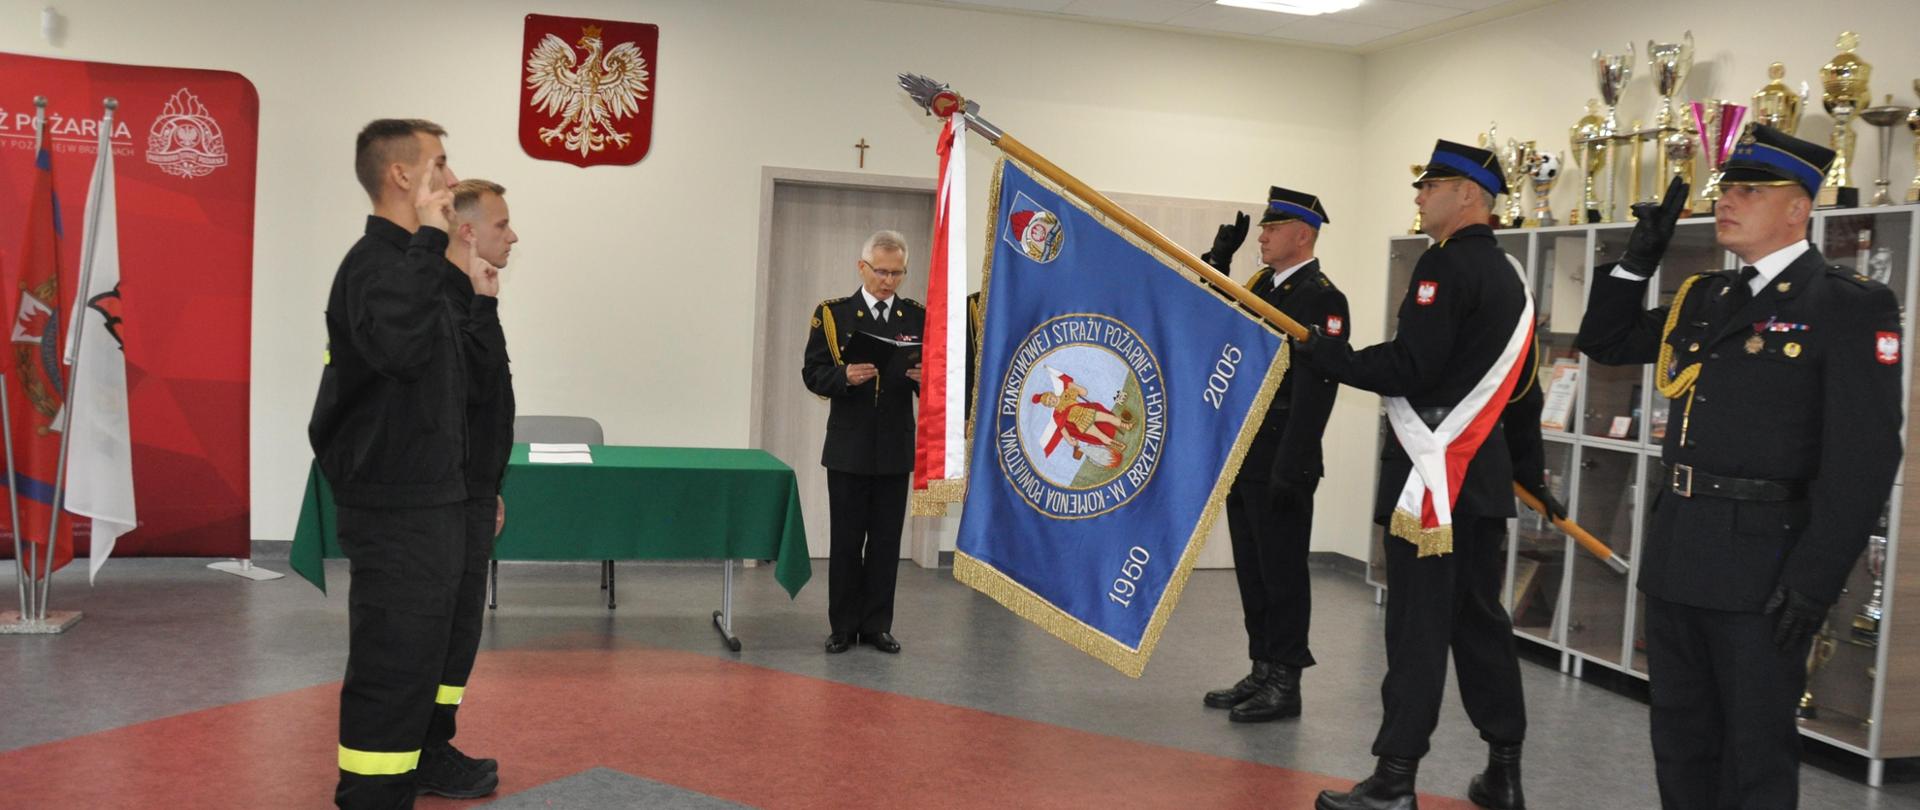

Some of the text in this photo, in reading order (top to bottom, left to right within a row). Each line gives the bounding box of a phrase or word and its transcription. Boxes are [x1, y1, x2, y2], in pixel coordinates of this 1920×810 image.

[1001, 317, 1157, 514] KOMENDA POWIATOWA PAŃSTWOWEJ STRAŻY POŻARNEJ
[1203, 343, 1243, 410] 2005
[1126, 391, 1164, 488] BRZEZINACH
[1108, 546, 1150, 609] 1950
